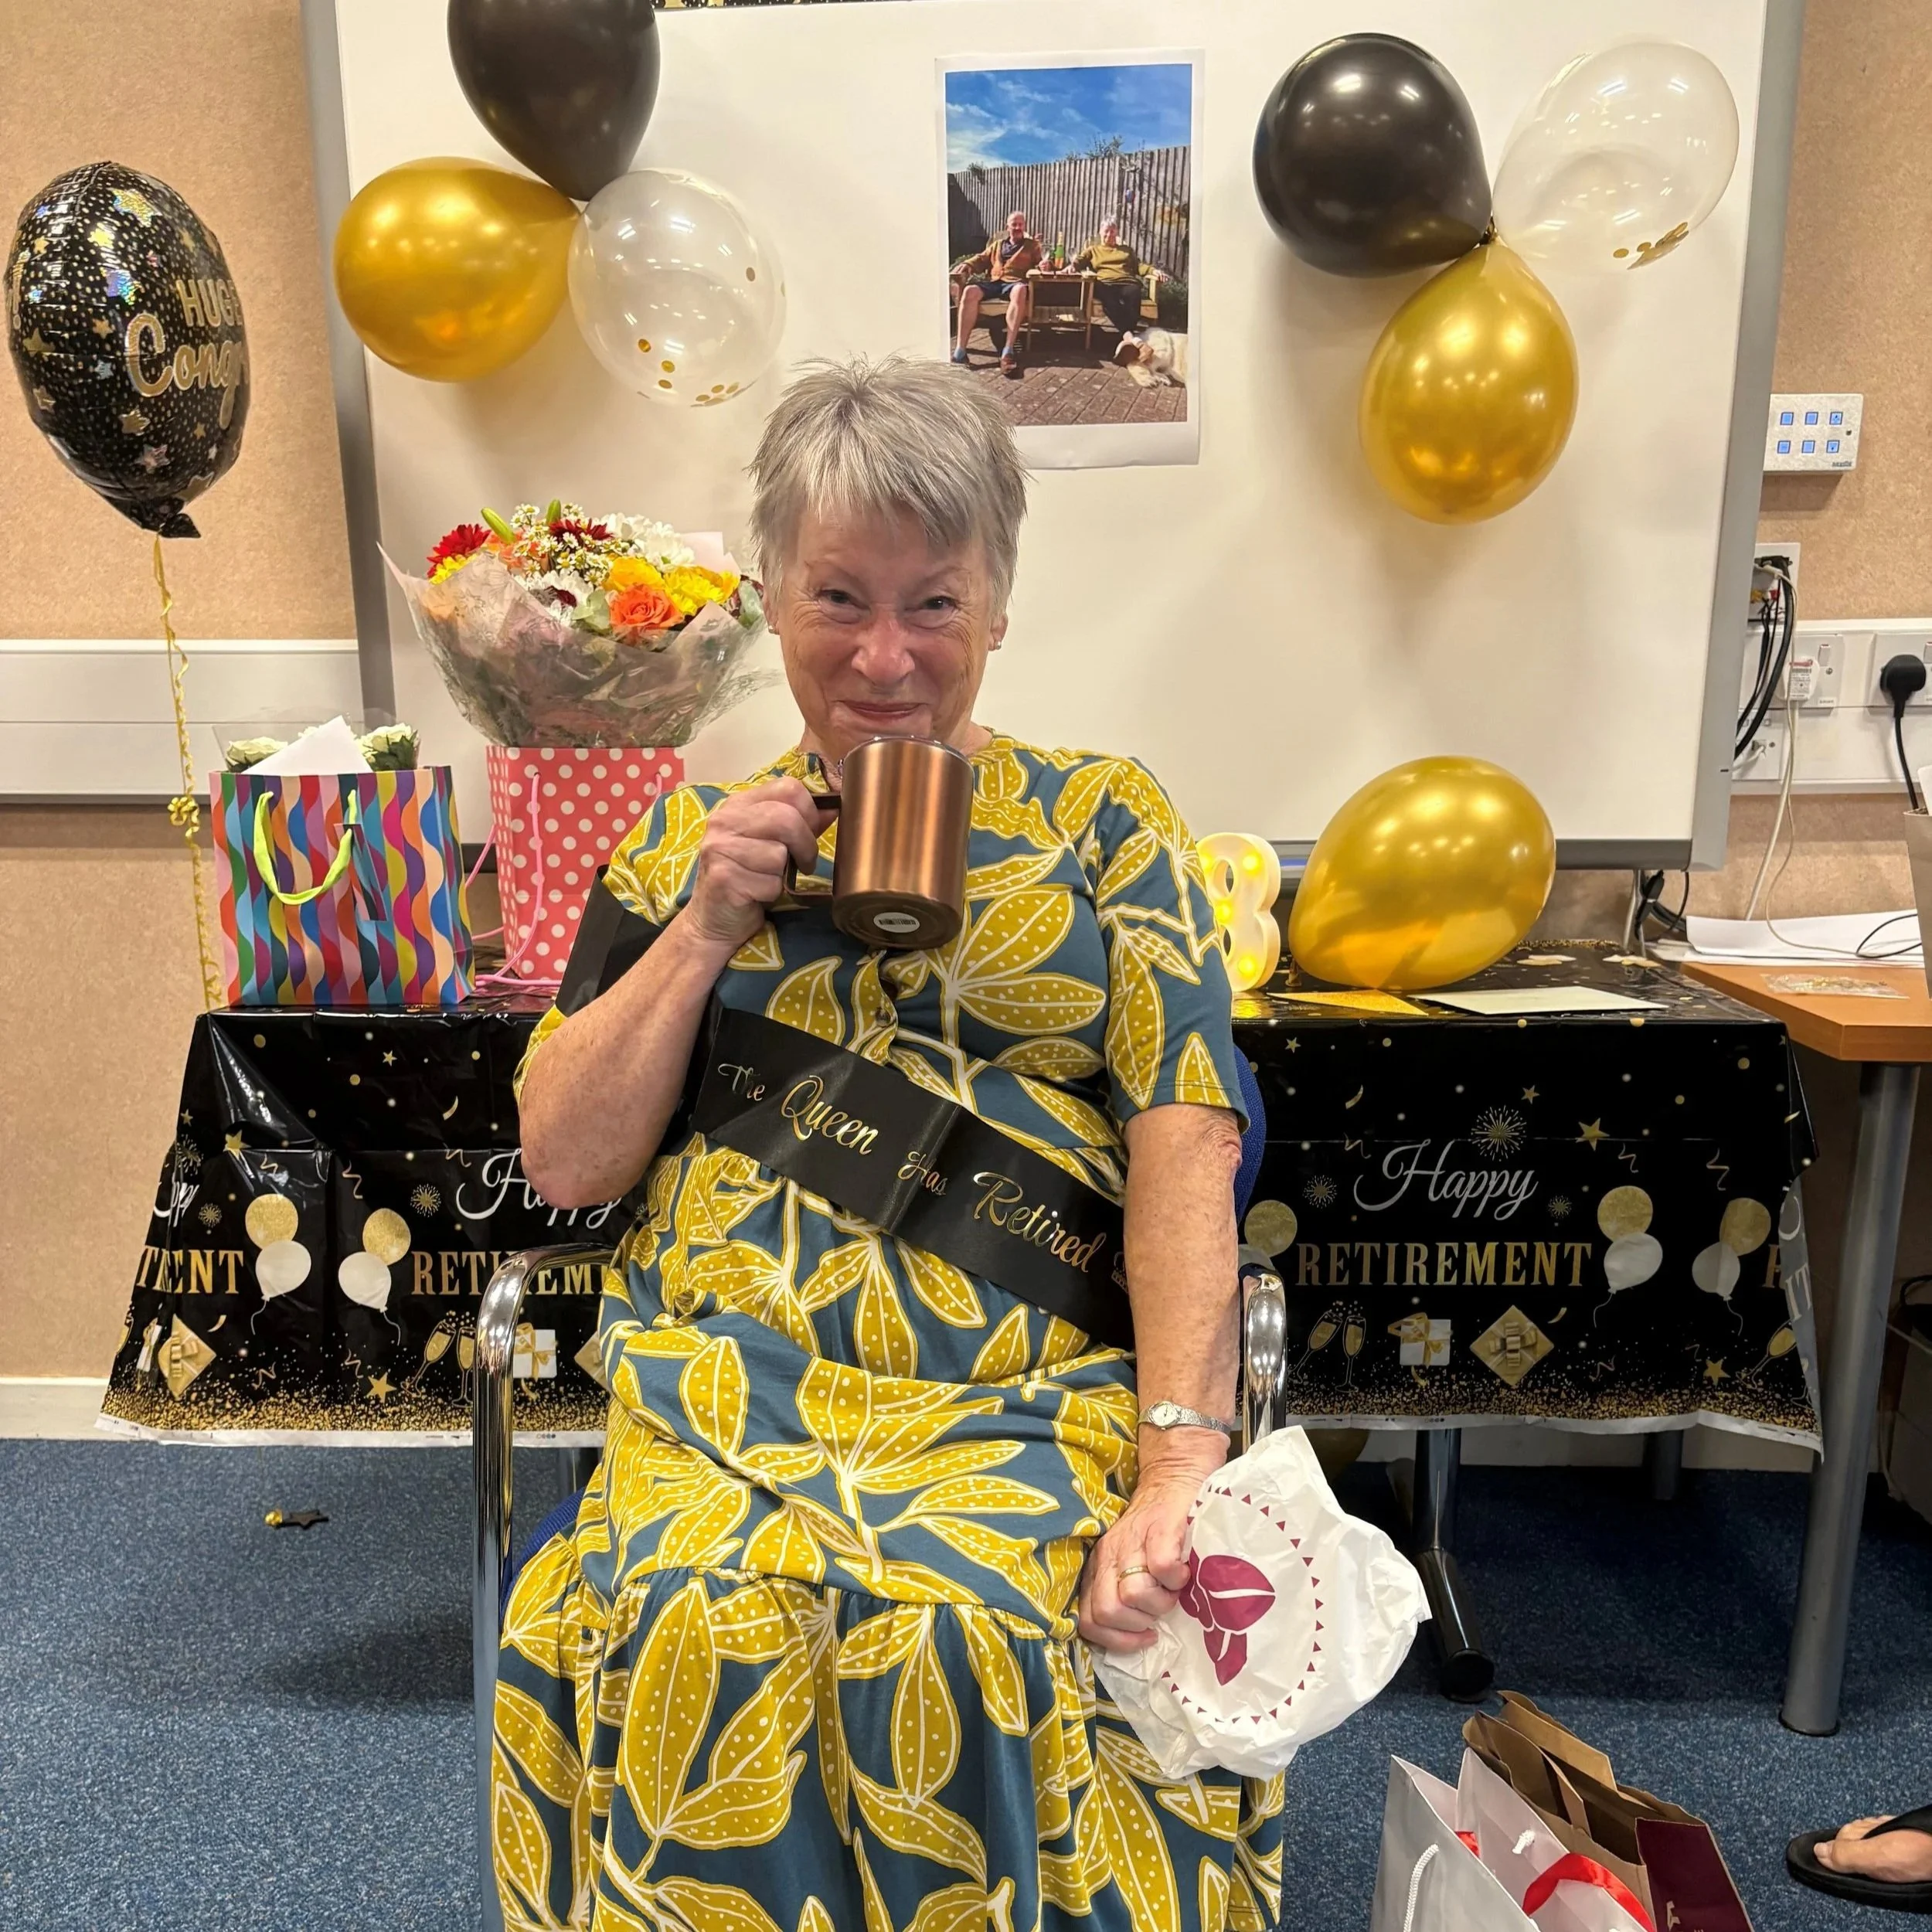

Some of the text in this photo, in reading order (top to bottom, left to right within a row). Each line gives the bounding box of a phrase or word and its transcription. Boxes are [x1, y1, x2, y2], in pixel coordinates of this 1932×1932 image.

[176, 279, 243, 327] HUGE
[718, 1063, 1107, 1273] The Queen Has Retired
[1353, 1138, 1539, 1221] Happy
[1295, 1242, 1593, 1287] RETIREMENT
